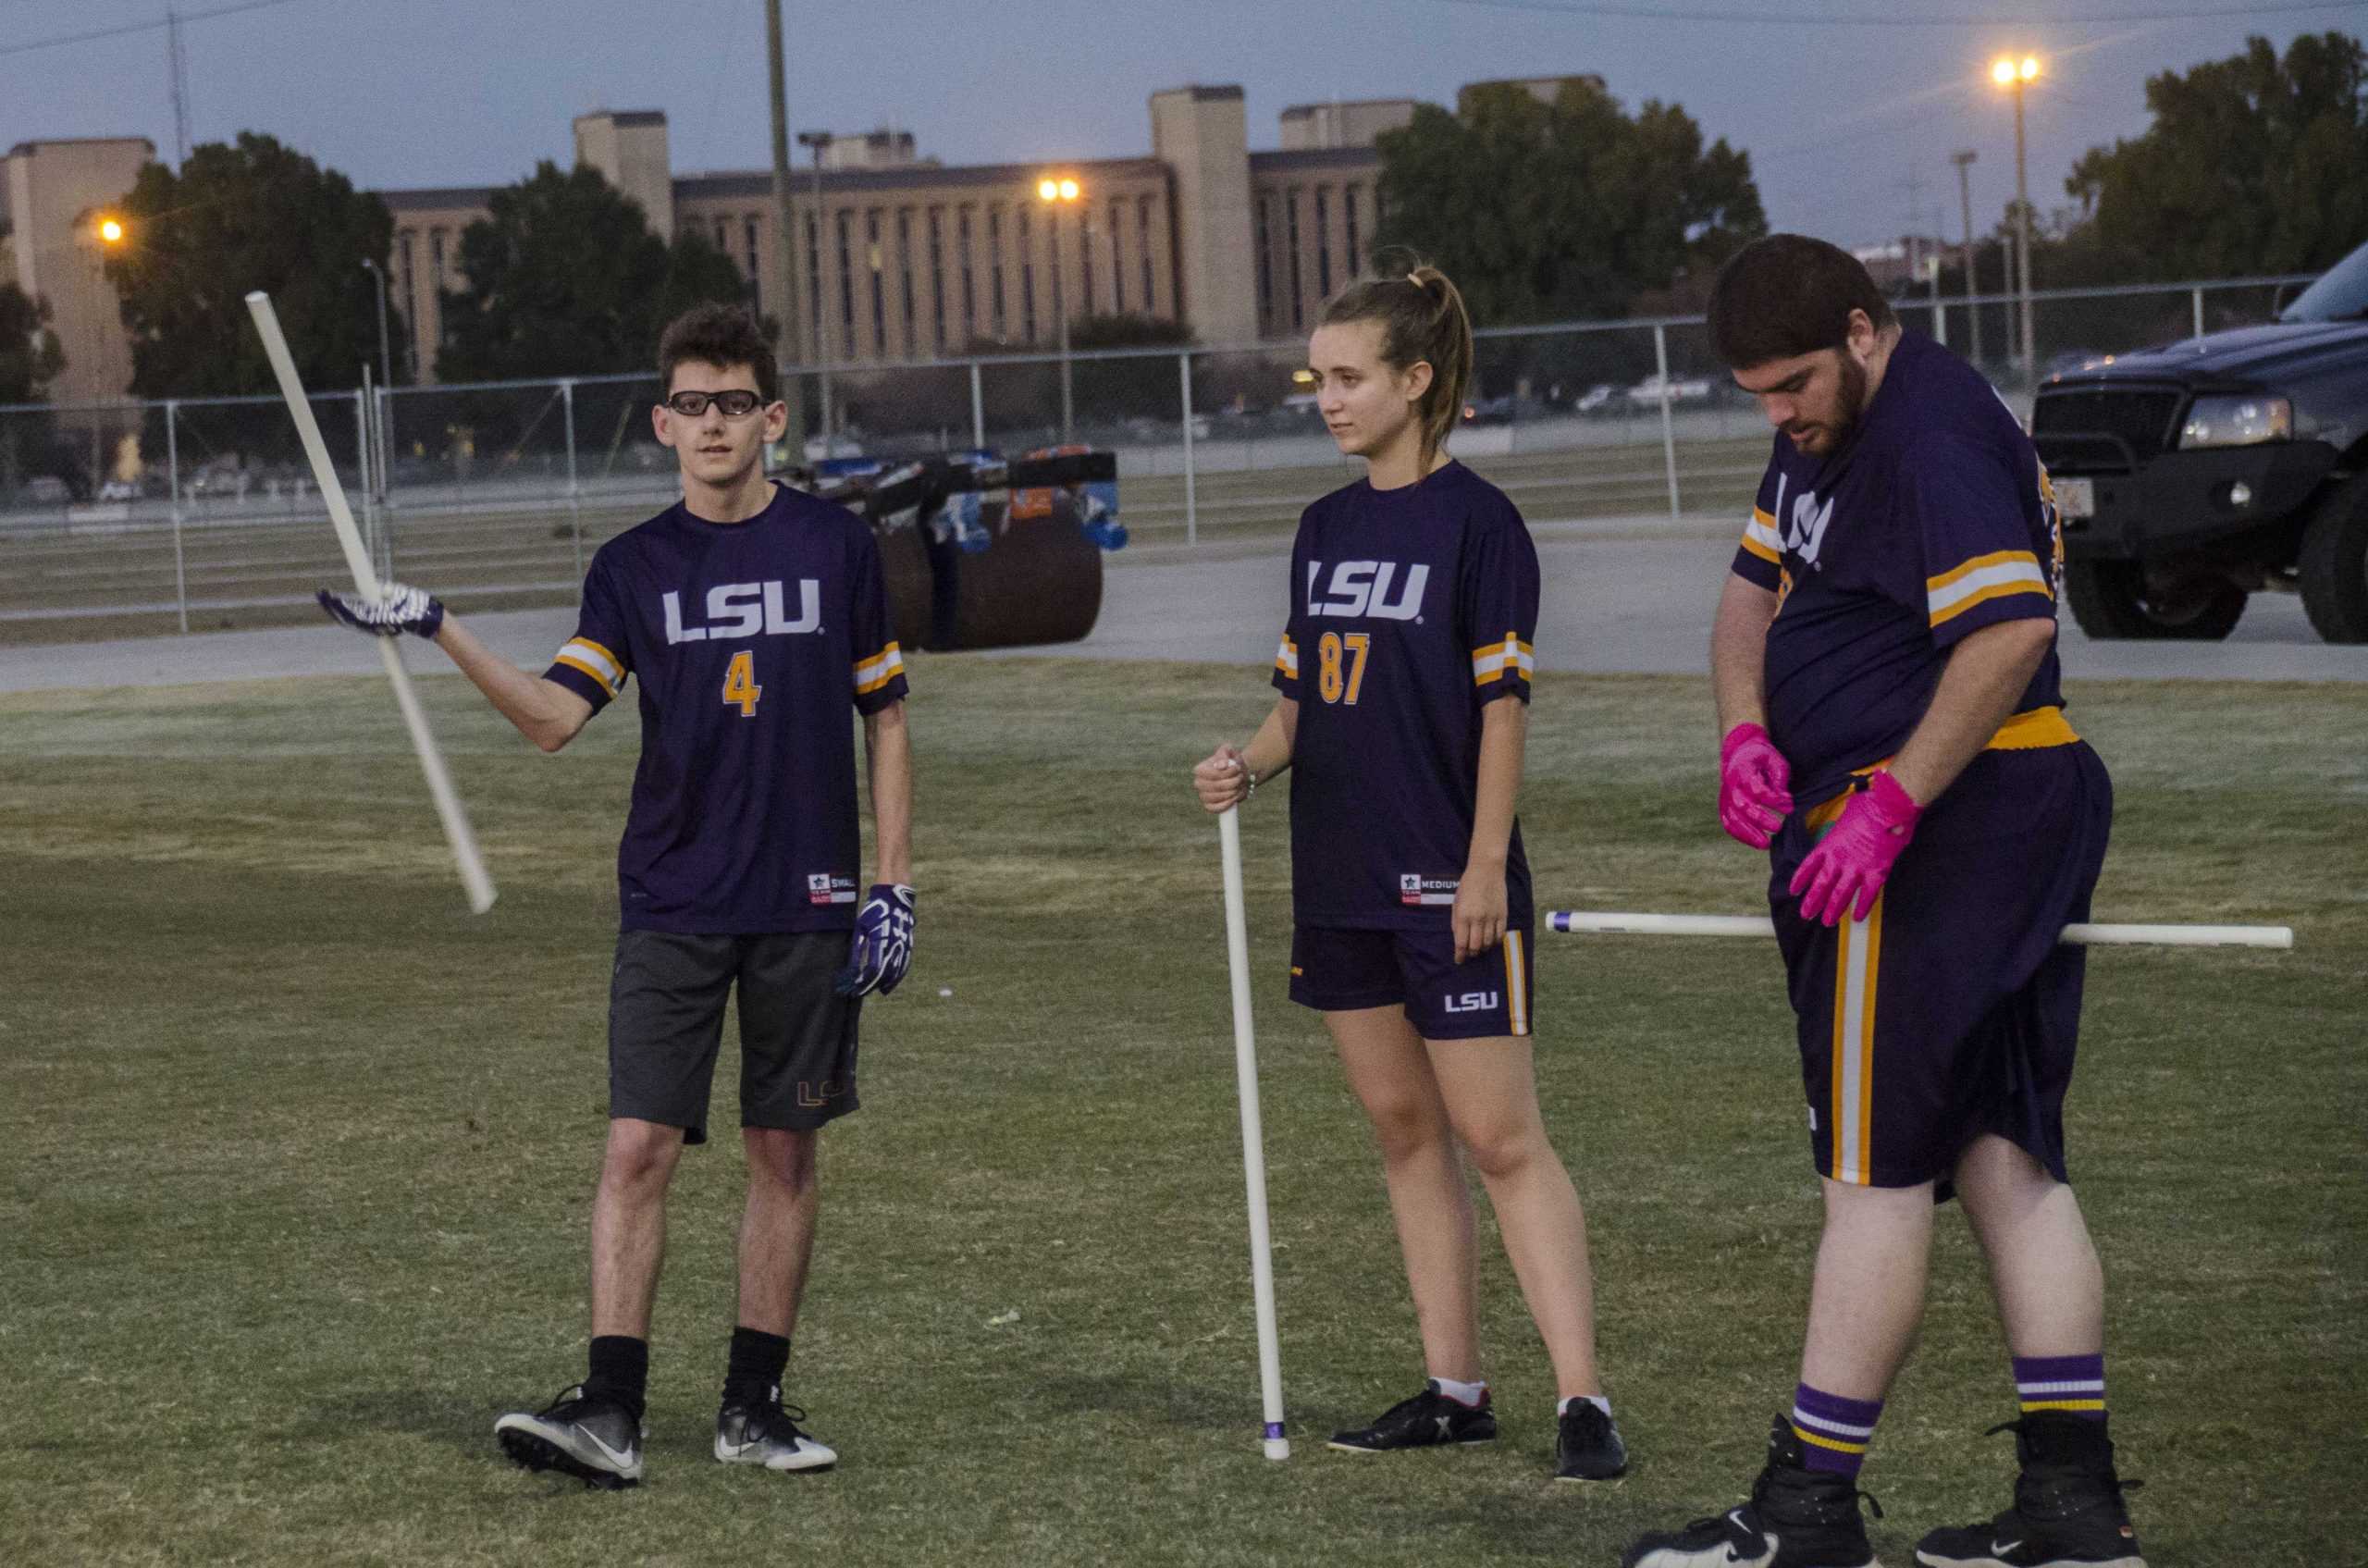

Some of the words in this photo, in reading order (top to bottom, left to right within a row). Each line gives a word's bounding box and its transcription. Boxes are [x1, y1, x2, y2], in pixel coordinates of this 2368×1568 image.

[662, 579, 820, 645] LSU
[1308, 560, 1430, 621] LSU
[722, 649, 762, 717] 4
[1319, 631, 1370, 705] 87
[1421, 880, 1461, 889] MEDIUM
[1445, 991, 1498, 1013] LSU
